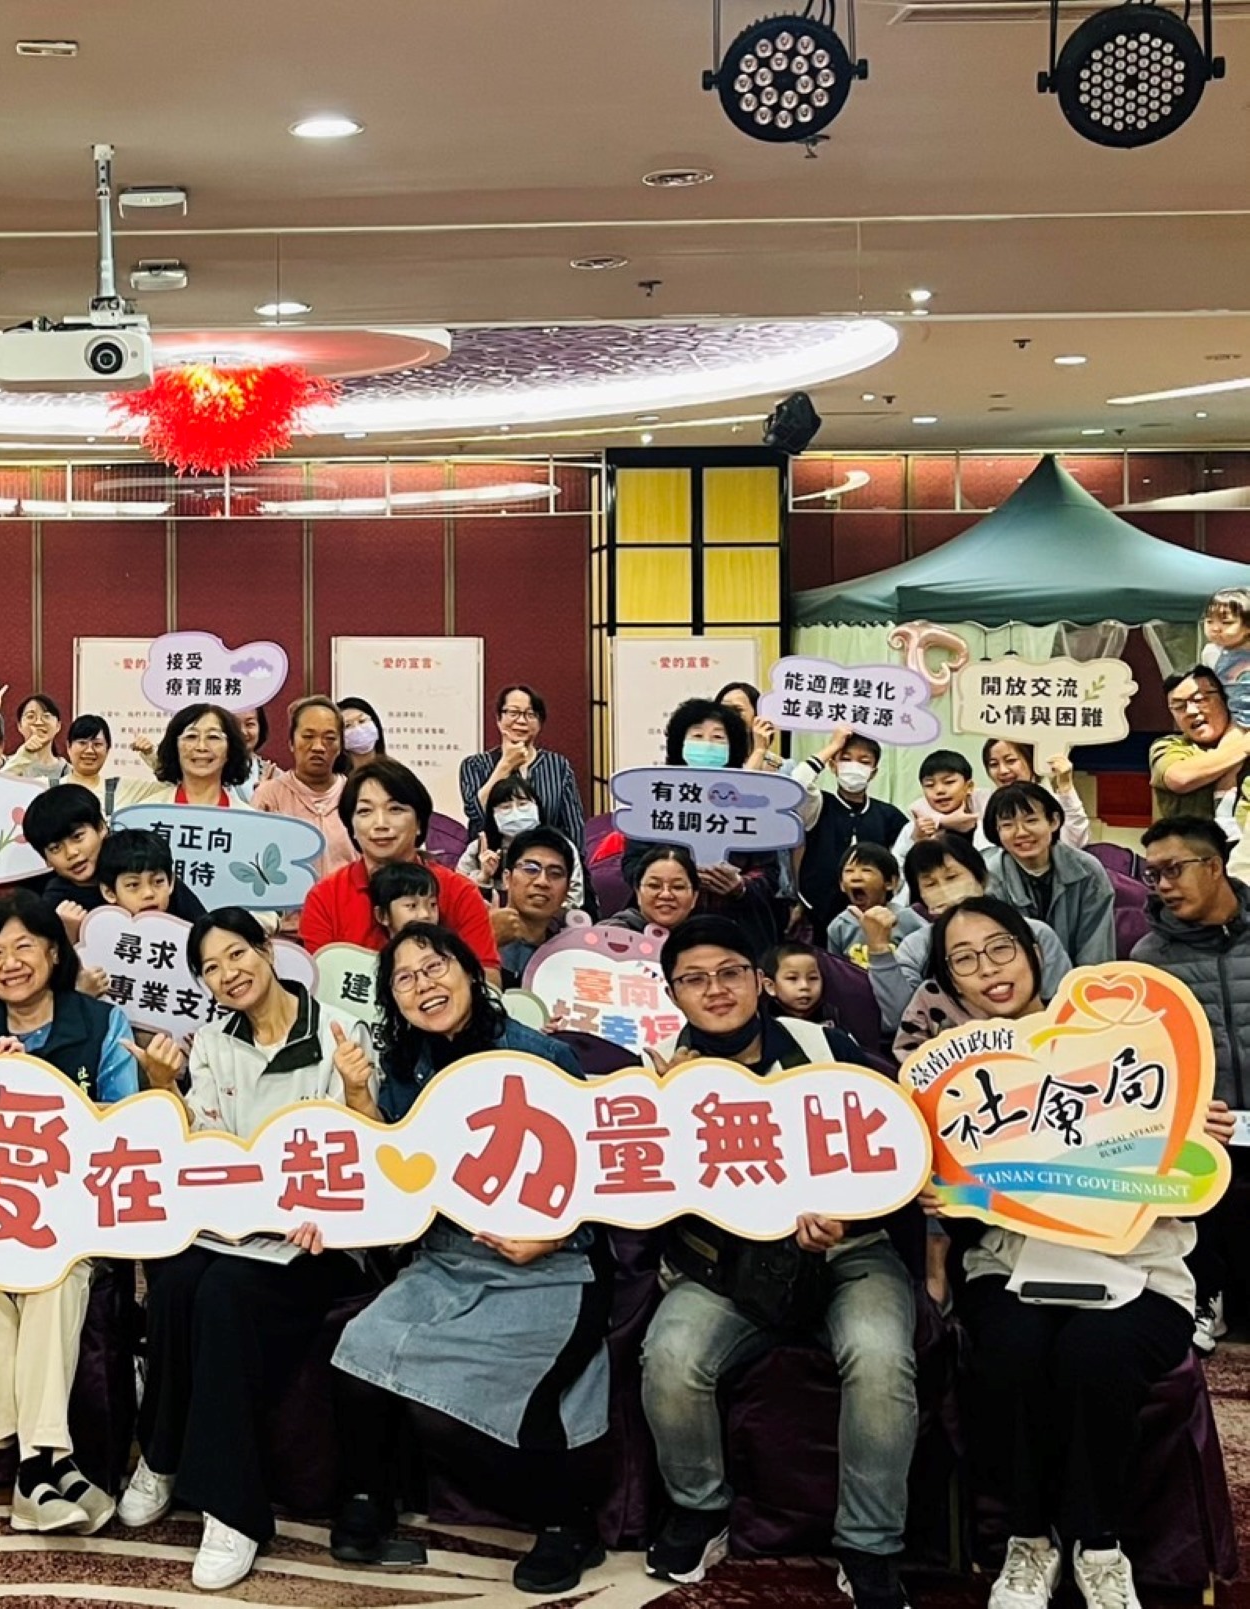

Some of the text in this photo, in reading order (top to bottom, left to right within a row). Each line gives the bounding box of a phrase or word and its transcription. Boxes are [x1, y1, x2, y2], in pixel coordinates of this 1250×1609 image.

[167, 652, 203, 670] 接受
[166, 678, 242, 696] 療育服務
[784, 672, 895, 701] 能適應變化
[980, 676, 1078, 698] 開放交流
[782, 698, 894, 727] 並尋求資源
[980, 704, 1103, 727] 心情與困難
[651, 780, 703, 803] 有效
[651, 810, 758, 836] 協調分工
[113, 932, 178, 970] 尋求
[573, 967, 659, 1010] 臺南
[941, 1048, 1165, 1150] 社會局
[452, 1075, 898, 1219] 力量無比
[1096, 1123, 1165, 1148] SOCIAL AFFAIRS
[975, 1170, 1191, 1197] TAINAN CITY GOVERNMENT
